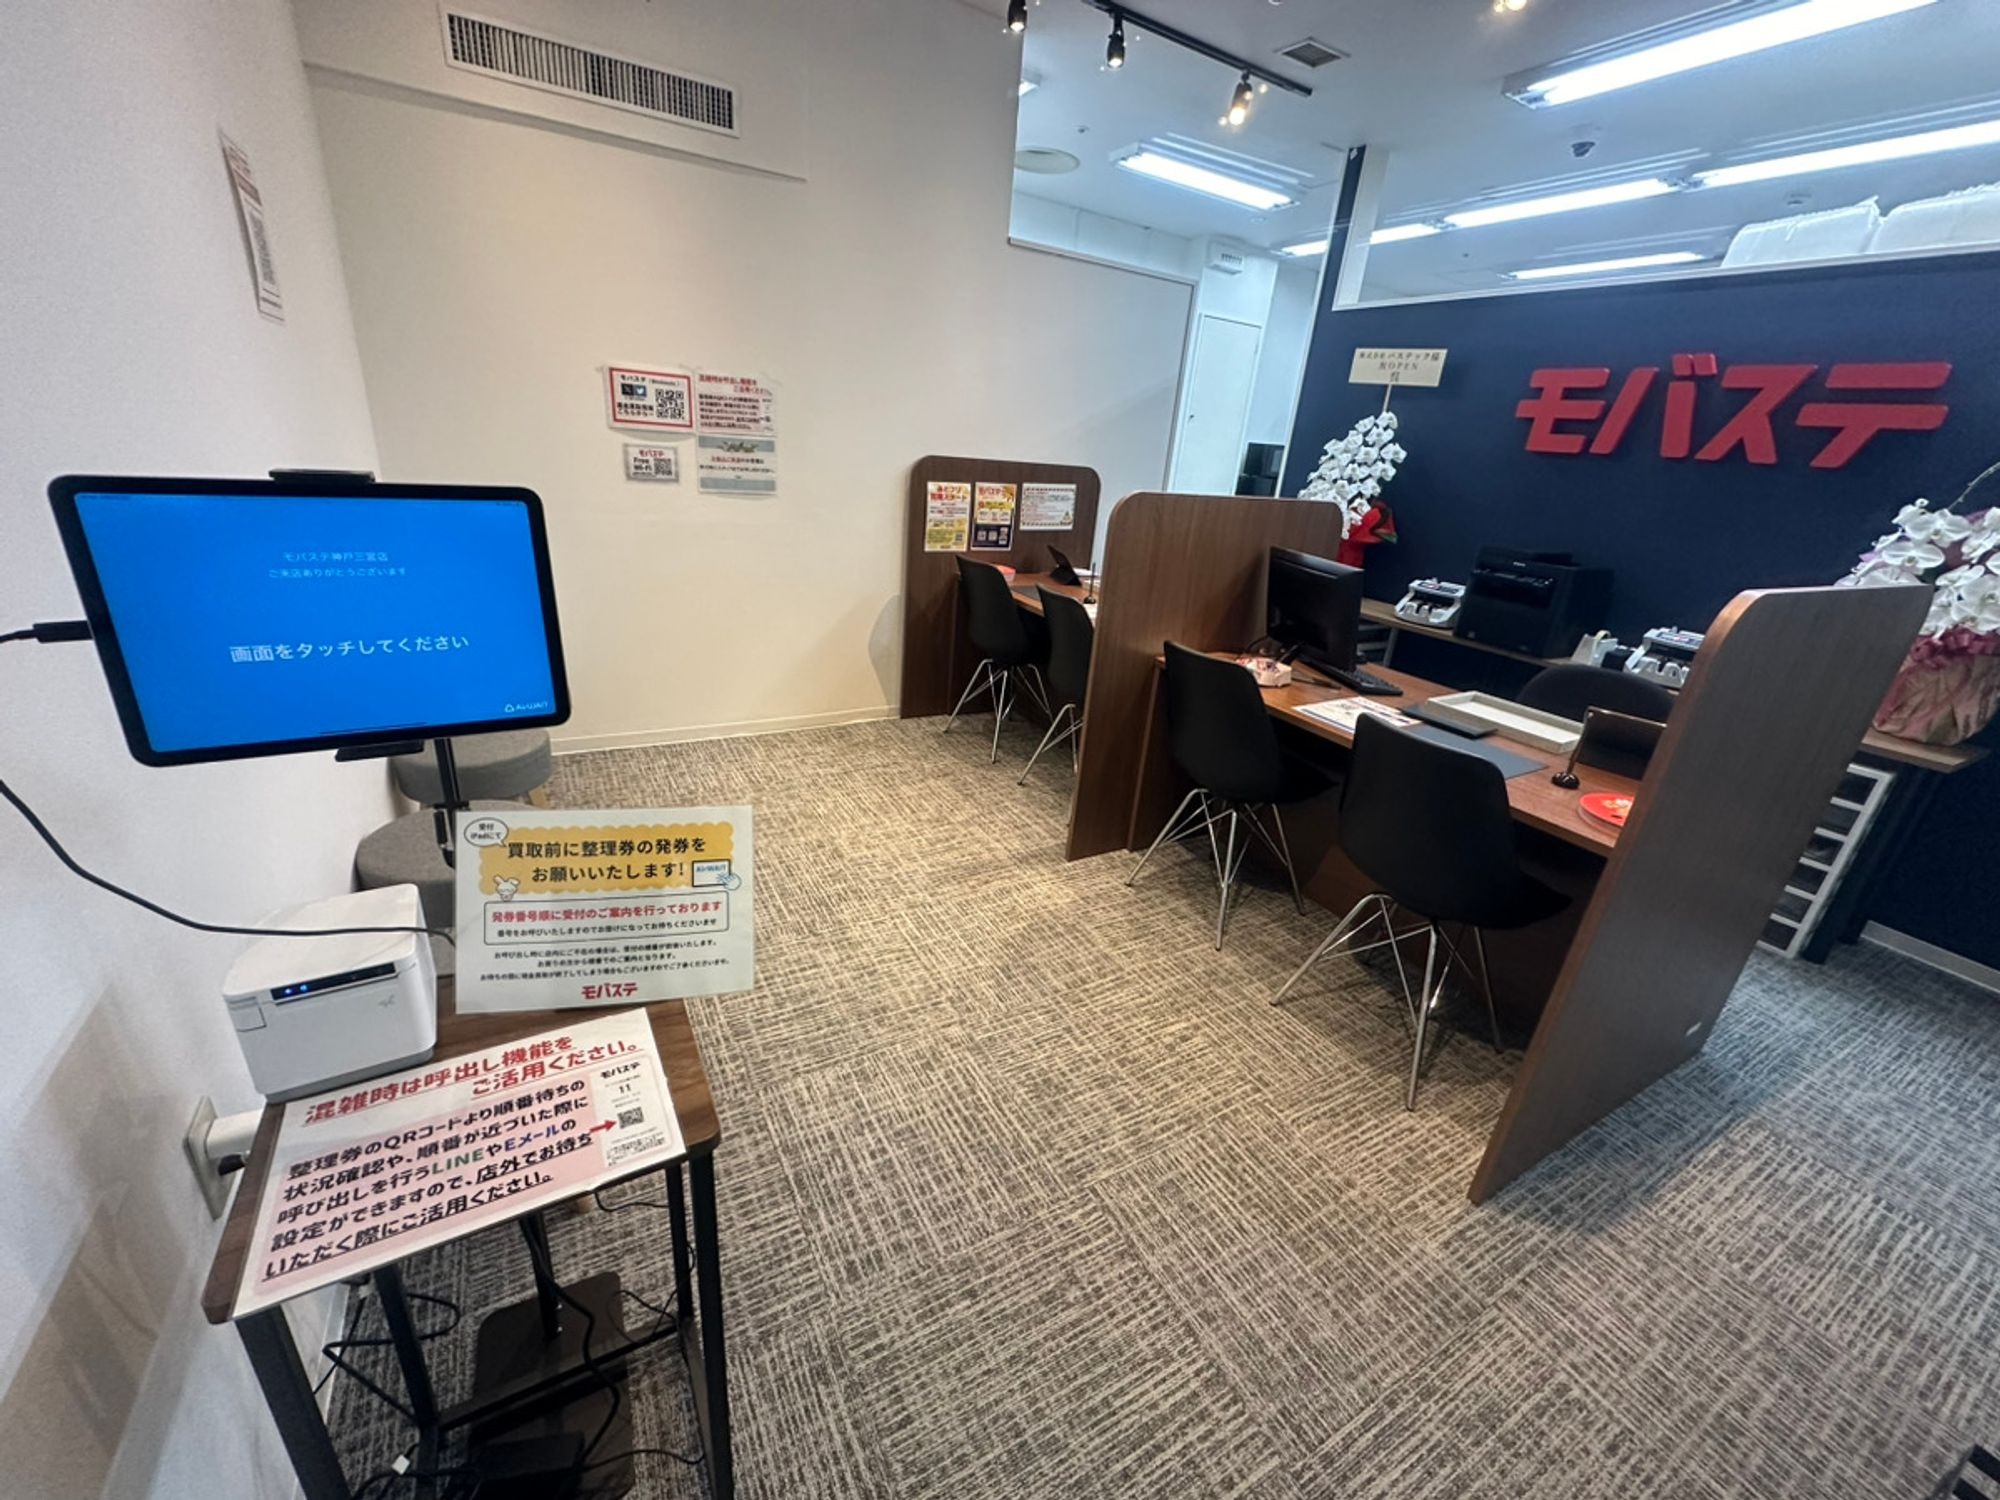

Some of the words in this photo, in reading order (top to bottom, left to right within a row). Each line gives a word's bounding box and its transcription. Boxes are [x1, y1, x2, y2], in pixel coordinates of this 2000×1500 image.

[1515, 353, 1951, 469] モバステ
[634, 464, 653, 472] Wi-Fi
[283, 551, 389, 562] モバステ神戸三宮店
[268, 567, 406, 578] ご来店ありがとうございます
[229, 635, 469, 663] 画面をタッチしてください
[479, 823, 495, 831] 受付
[508, 838, 706, 859] 買取前に整理券の発券を
[532, 862, 685, 883] お願いいたします!
[492, 901, 722, 923] 発券番号順に受付のご案内を行っております
[581, 982, 638, 999] モバステ
[306, 1036, 573, 1124] 混雑時は呼出し機能を
[472, 1041, 638, 1096] ご活用ください。
[601, 1062, 641, 1079] モバステ
[288, 1079, 585, 1181] 整理券のQRコードより順番待ちの
[283, 1096, 588, 1202] 状況確認や、順番が近づいた際に
[277, 1118, 576, 1224] 呼び出しを行うLINEやEメールの
[271, 1132, 593, 1252] 設定ができますので、店外でお待ち
[264, 1172, 554, 1277] いただく際にご活用ください。
